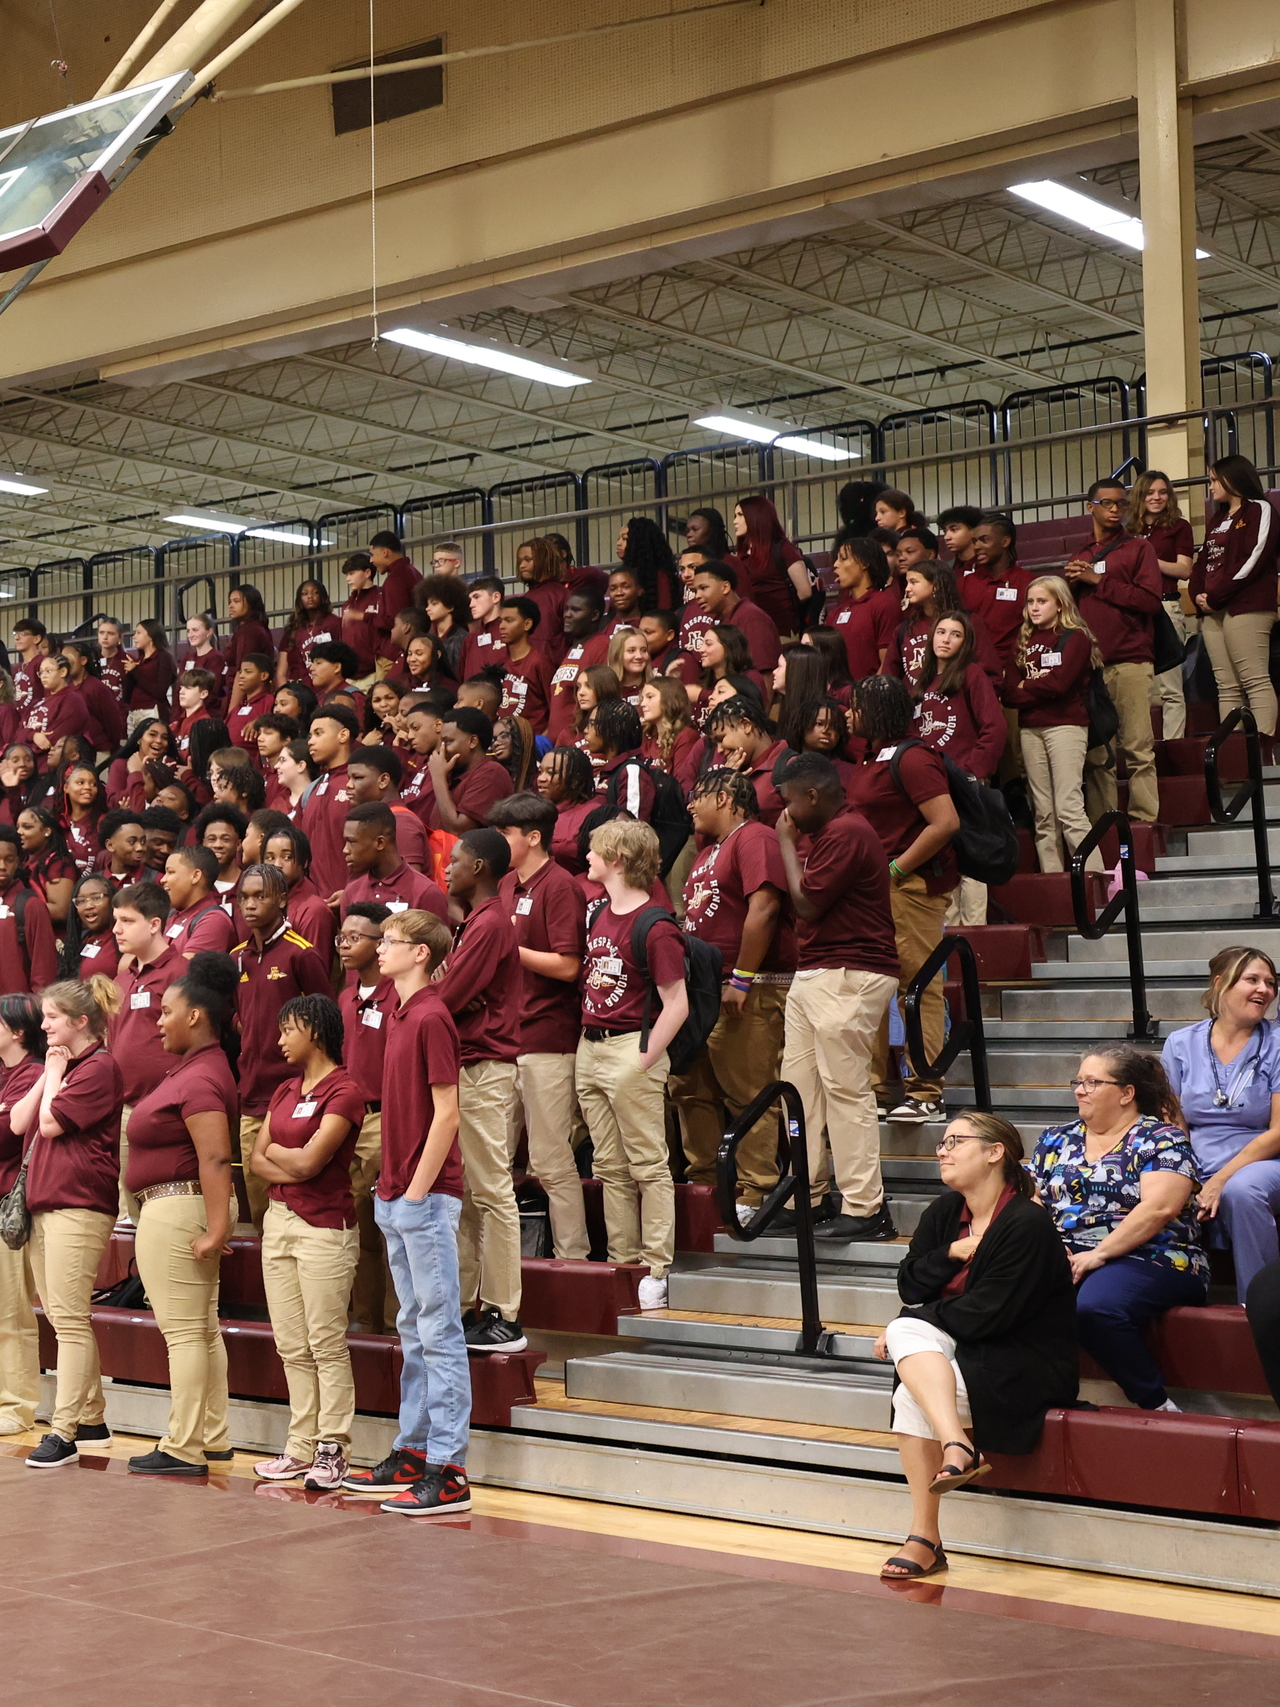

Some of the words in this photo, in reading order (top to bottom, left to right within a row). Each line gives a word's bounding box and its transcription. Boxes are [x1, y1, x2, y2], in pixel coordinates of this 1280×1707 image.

[936, 715, 957, 747] HONOR
[704, 879, 721, 918] HONOR
[604, 973, 628, 1008] HONOR
